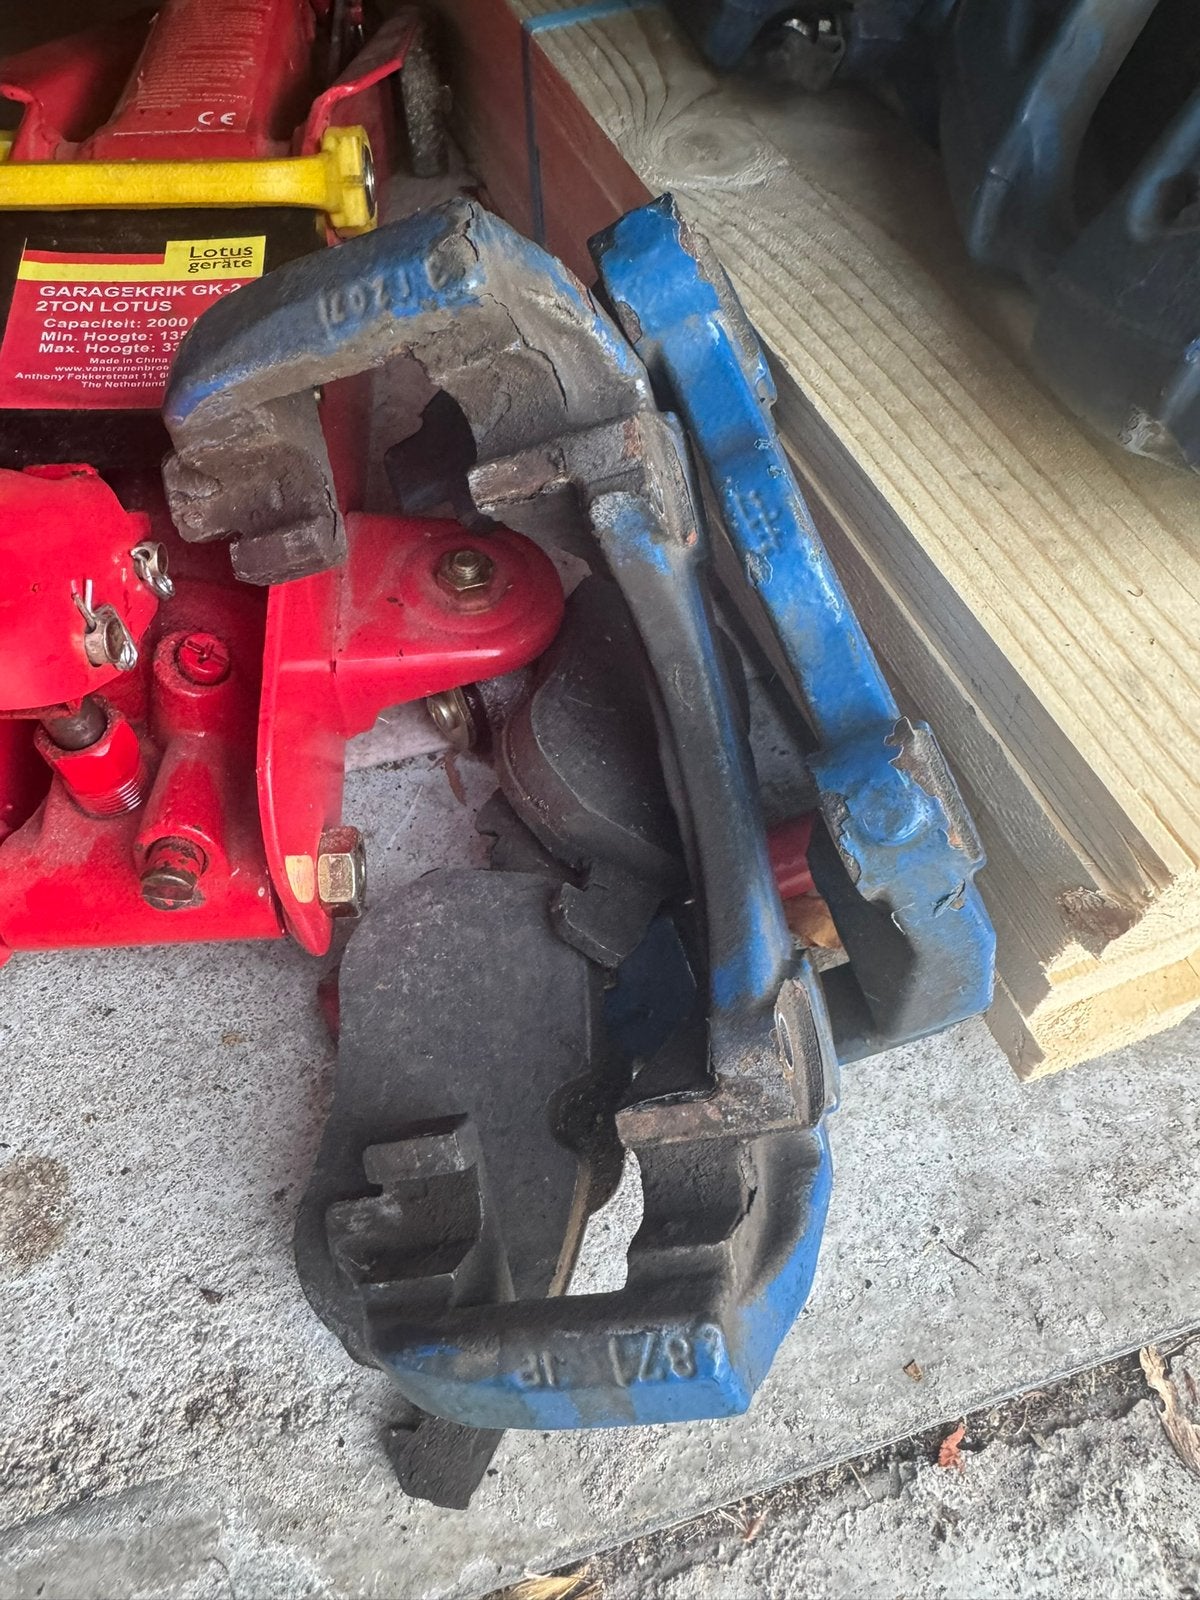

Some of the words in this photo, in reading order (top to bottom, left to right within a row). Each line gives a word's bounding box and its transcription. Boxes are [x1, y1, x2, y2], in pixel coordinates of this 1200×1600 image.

[198, 111, 236, 126] CE
[190, 246, 253, 258] Lotus
[188, 258, 252, 273] geräte
[39, 286, 188, 297] GARAGEKRIK
[35, 301, 94, 312] 2TON
[100, 301, 172, 312] LOTUS
[43, 318, 141, 330] Capaciteit:
[146, 317, 188, 328] 2000
[41, 331, 78, 341] Min.
[83, 331, 153, 343] Hoogte:
[38, 343, 80, 353] Max.
[85, 343, 156, 355] Hoogte:
[14, 372, 65, 381] Anthony
